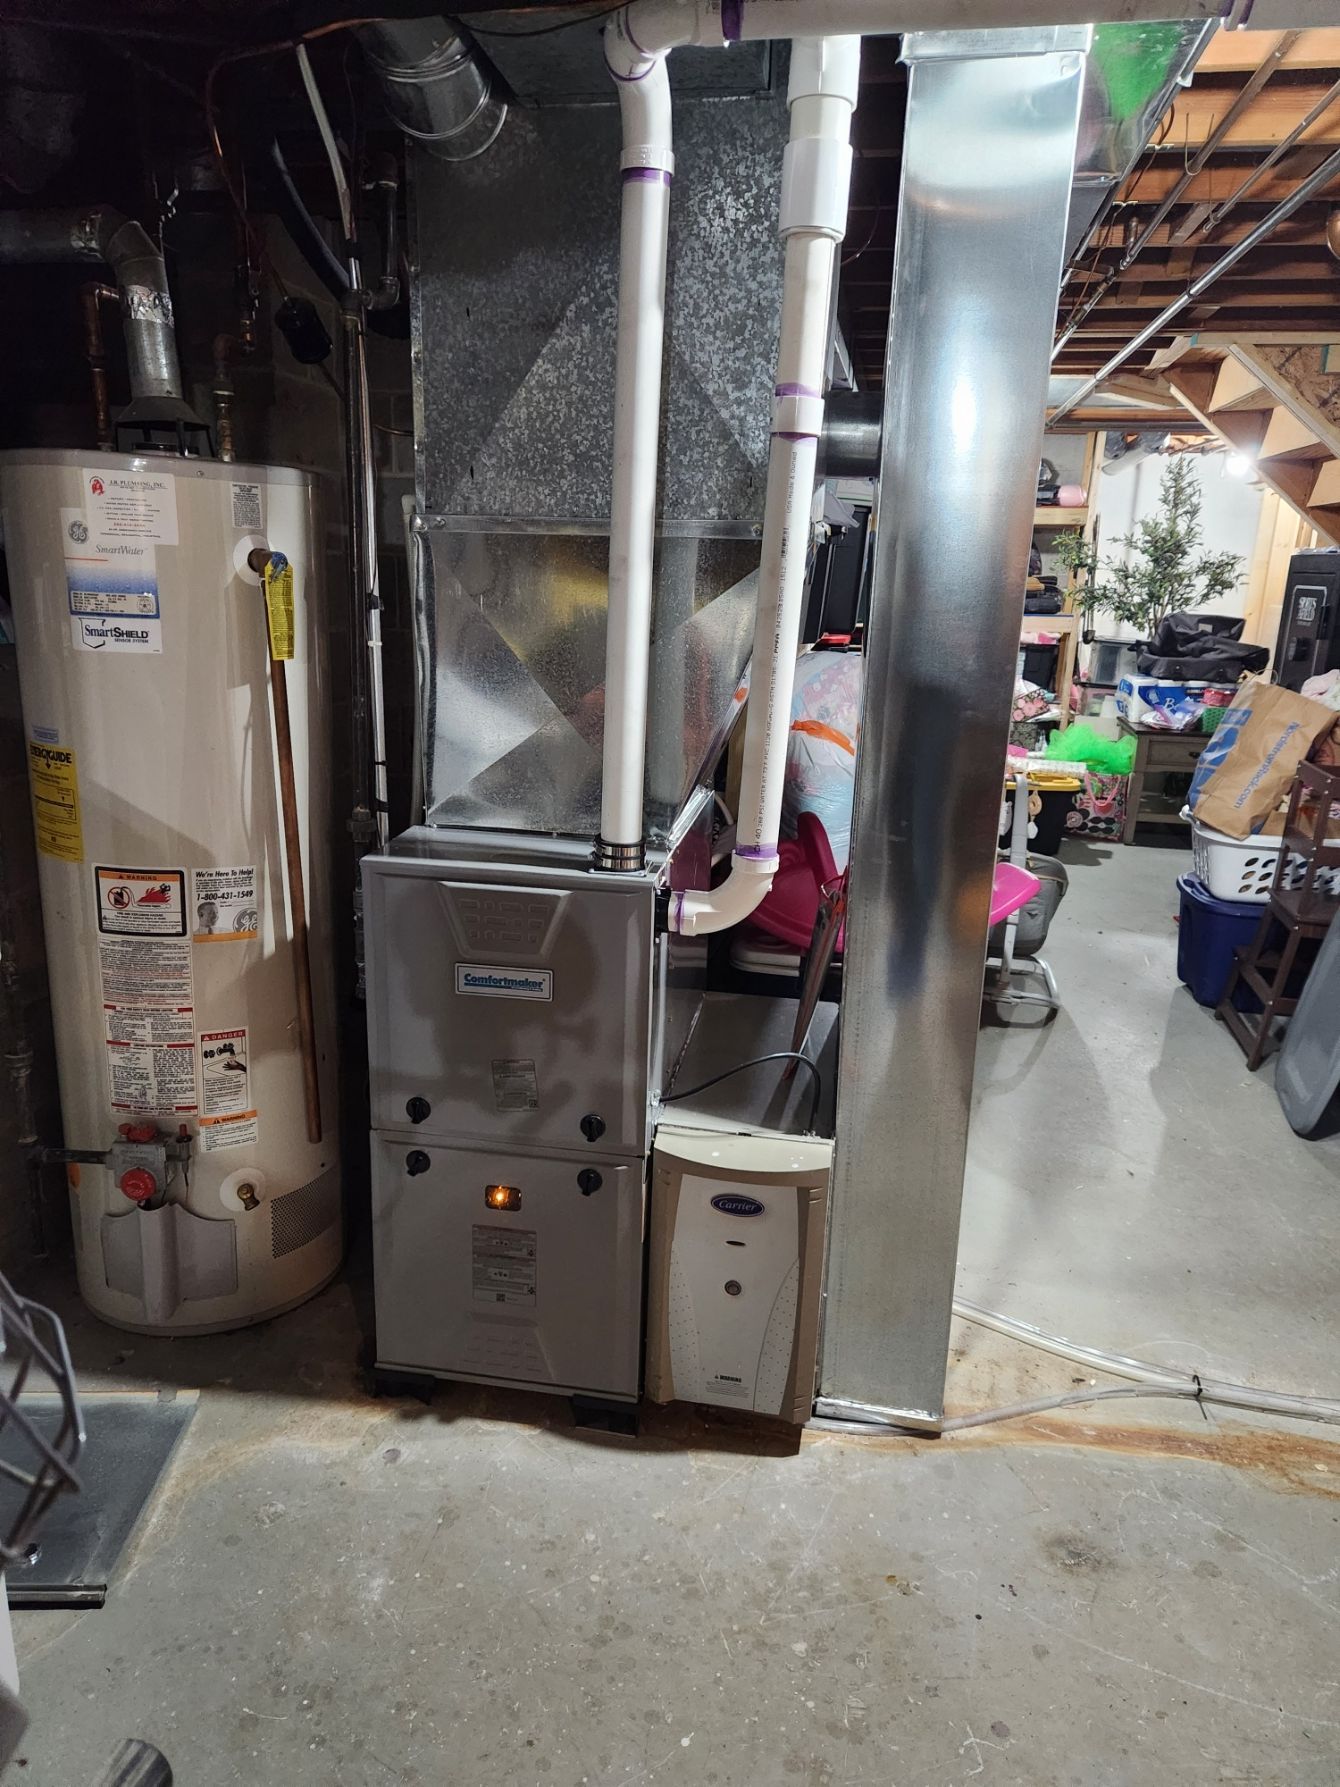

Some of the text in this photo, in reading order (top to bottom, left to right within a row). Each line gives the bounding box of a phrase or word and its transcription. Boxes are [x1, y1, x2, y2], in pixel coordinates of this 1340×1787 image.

[96, 544, 144, 555] SmartWater
[84, 624, 148, 639] SmartSHIELD
[239, 868, 254, 876] Help!
[197, 890, 253, 901] 1-800-431-1549
[464, 973, 543, 988] Comfortmaker
[212, 1031, 243, 1040] DANGER
[719, 1200, 757, 1210] Carrier
